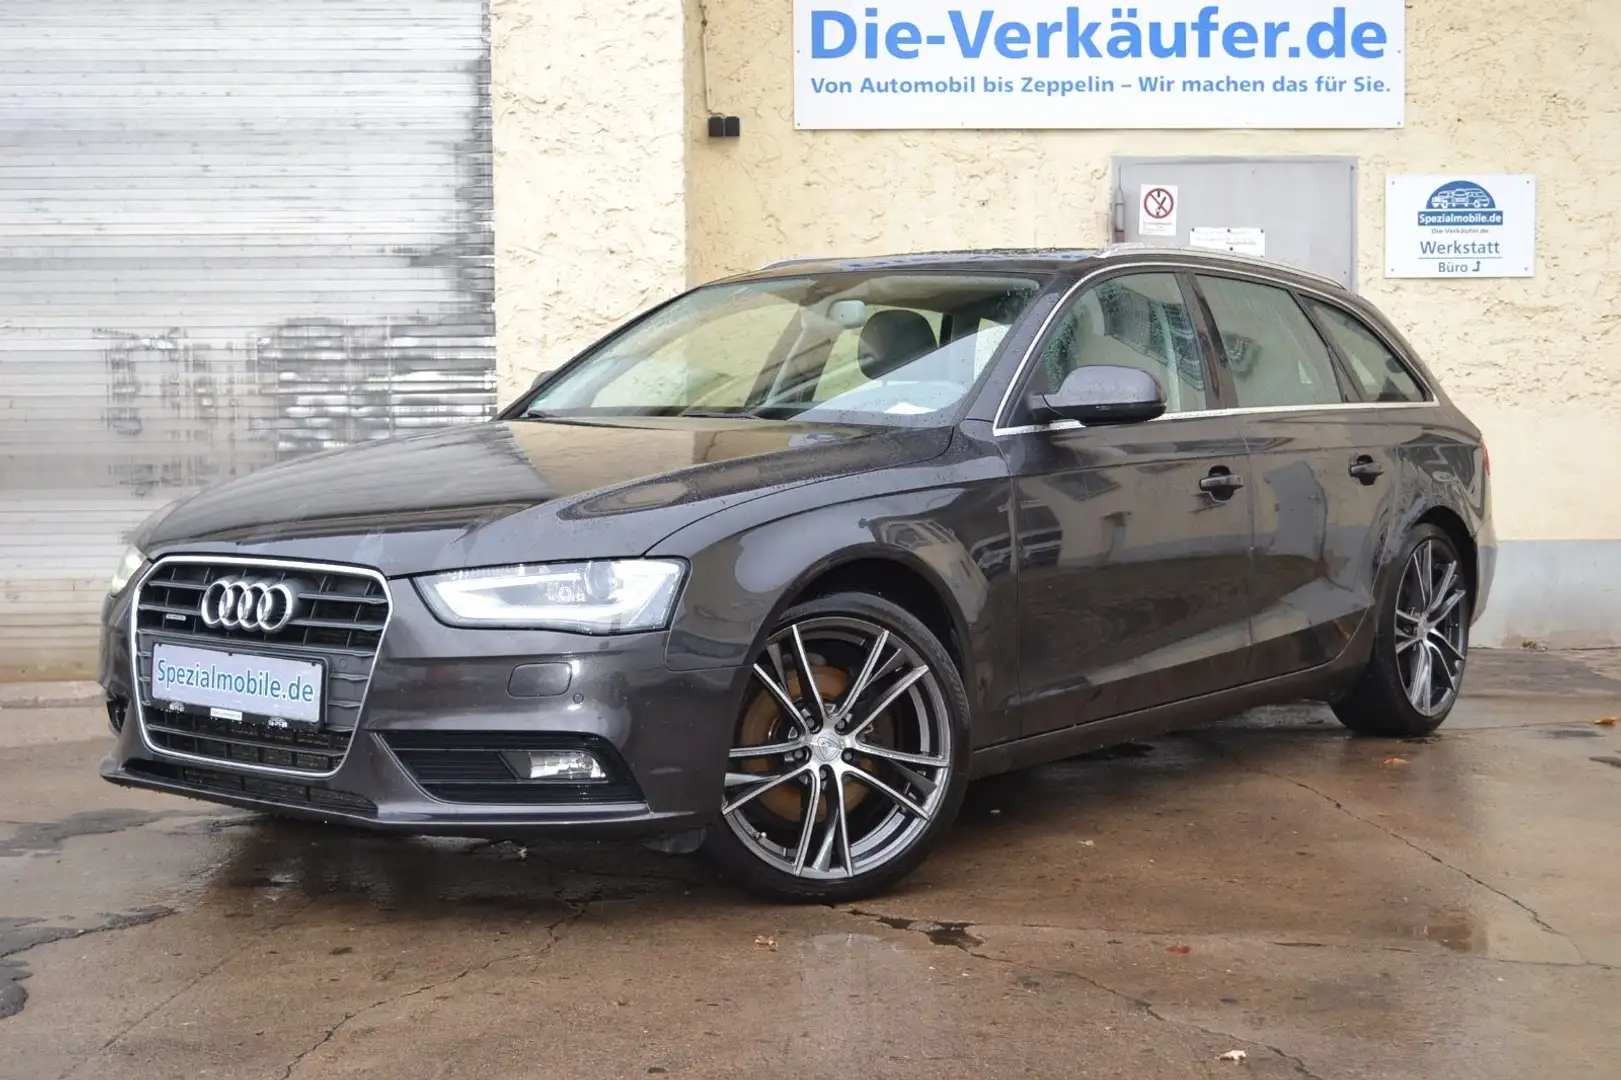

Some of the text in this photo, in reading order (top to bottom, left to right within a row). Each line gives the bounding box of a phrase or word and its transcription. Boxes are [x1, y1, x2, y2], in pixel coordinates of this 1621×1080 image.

[811, 6, 1387, 59] Die-Verkäufer.de
[811, 77, 852, 93] Von
[860, 76, 975, 93] Automobil
[983, 76, 1014, 93] bis
[1021, 76, 1114, 96] Zeppelin
[1138, 75, 1175, 92] Wir
[1182, 76, 1265, 92] machen
[1272, 75, 1308, 92] das
[1315, 75, 1346, 92] für
[1353, 75, 1391, 92] Sie.
[1419, 213, 1502, 224] Spezialmobile.de
[1420, 240, 1500, 254] Werkstatt
[1438, 261, 1468, 273] Büro
[157, 659, 314, 702] Spezialmobile.de
